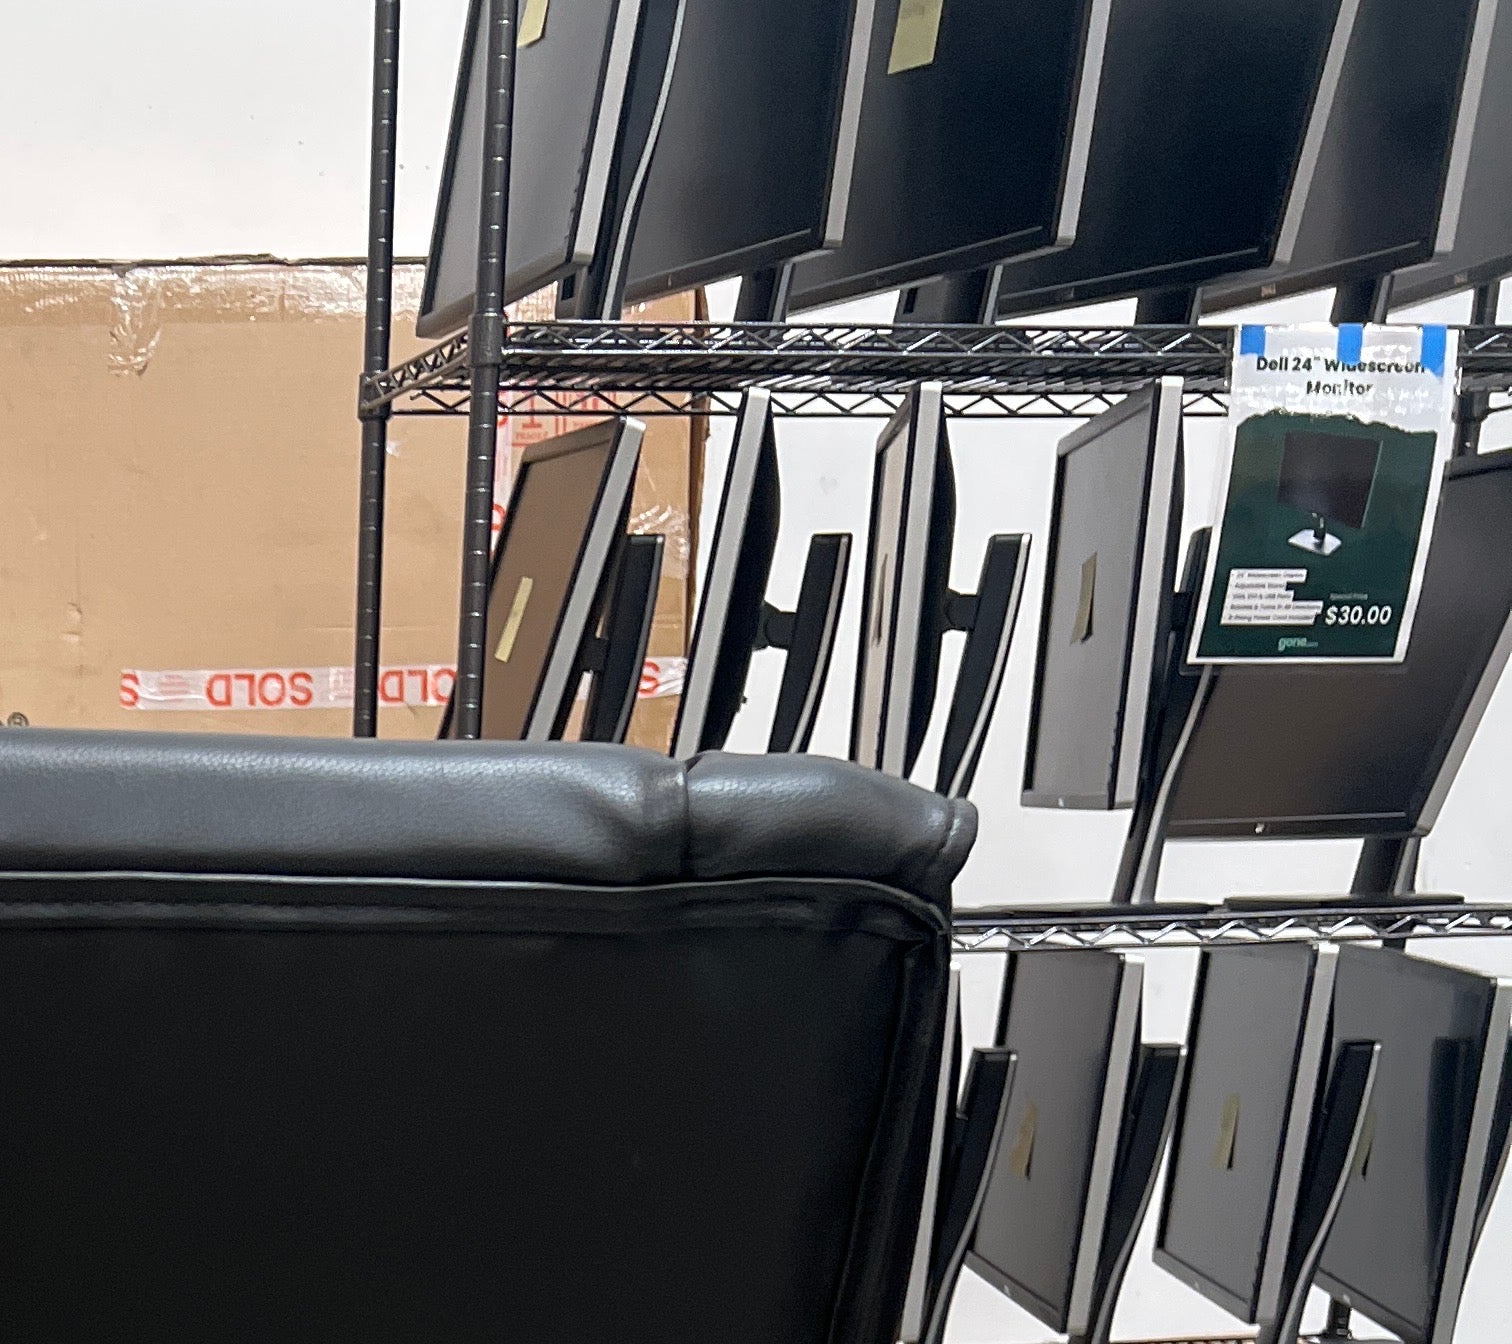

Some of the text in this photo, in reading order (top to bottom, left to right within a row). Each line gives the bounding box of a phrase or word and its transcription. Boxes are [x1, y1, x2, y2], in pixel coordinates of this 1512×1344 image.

[1256, 356, 1288, 372] Dell
[1306, 379, 1374, 396] Monitor
[1324, 604, 1392, 626] $30.00
[205, 667, 456, 707] SOLD OLD
